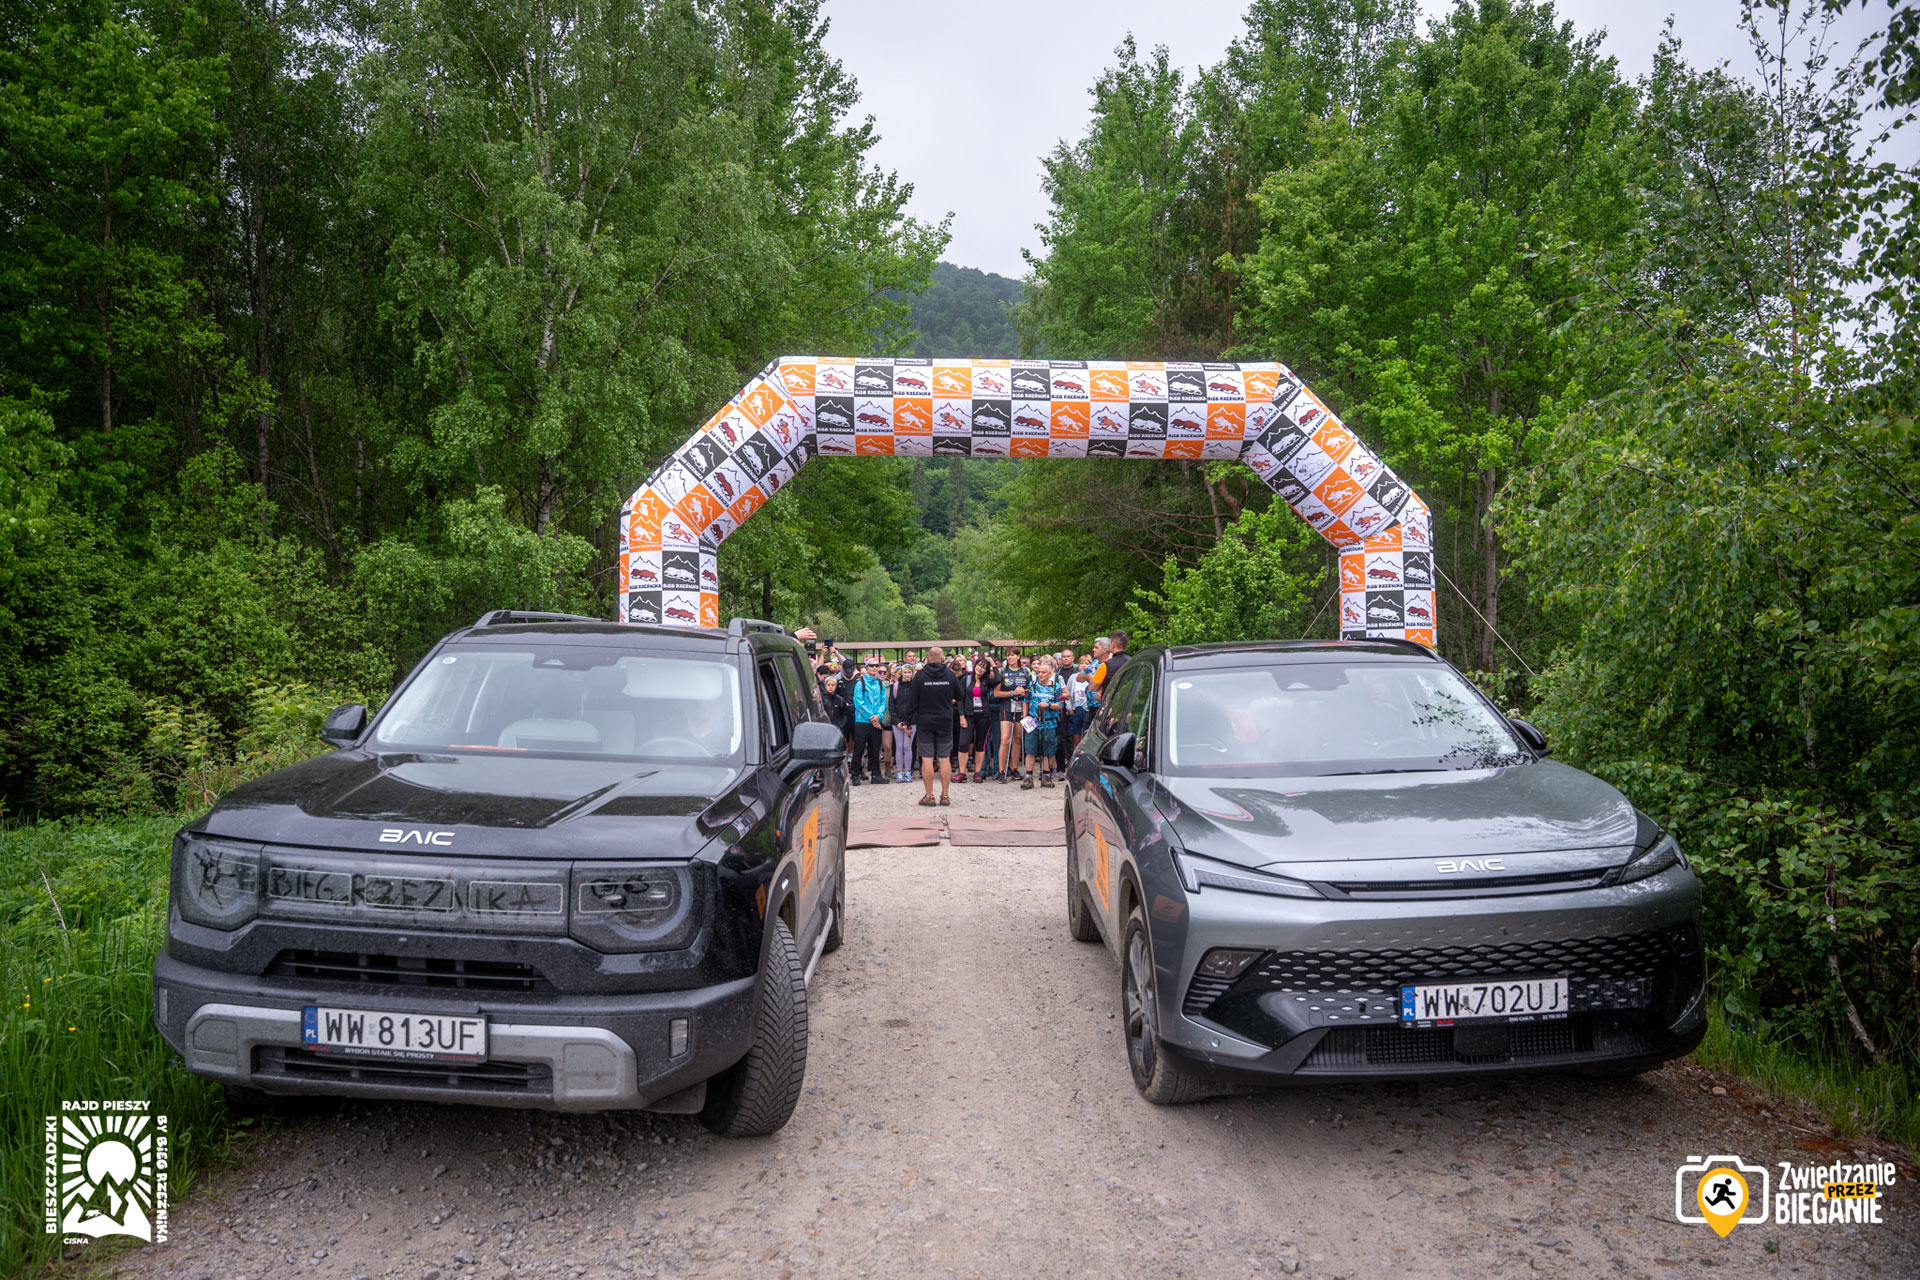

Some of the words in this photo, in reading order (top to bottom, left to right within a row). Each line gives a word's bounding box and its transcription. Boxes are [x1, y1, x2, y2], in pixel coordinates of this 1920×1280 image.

[379, 828, 456, 846] BAIC
[1435, 858, 1506, 874] BAIC
[1424, 988, 1460, 1018] WW
[1473, 982, 1559, 1015] 702UJ
[1403, 1007, 1415, 1017] PL
[305, 1028, 317, 1039] PL
[325, 1012, 365, 1044] WW
[378, 1016, 478, 1051] 813UF
